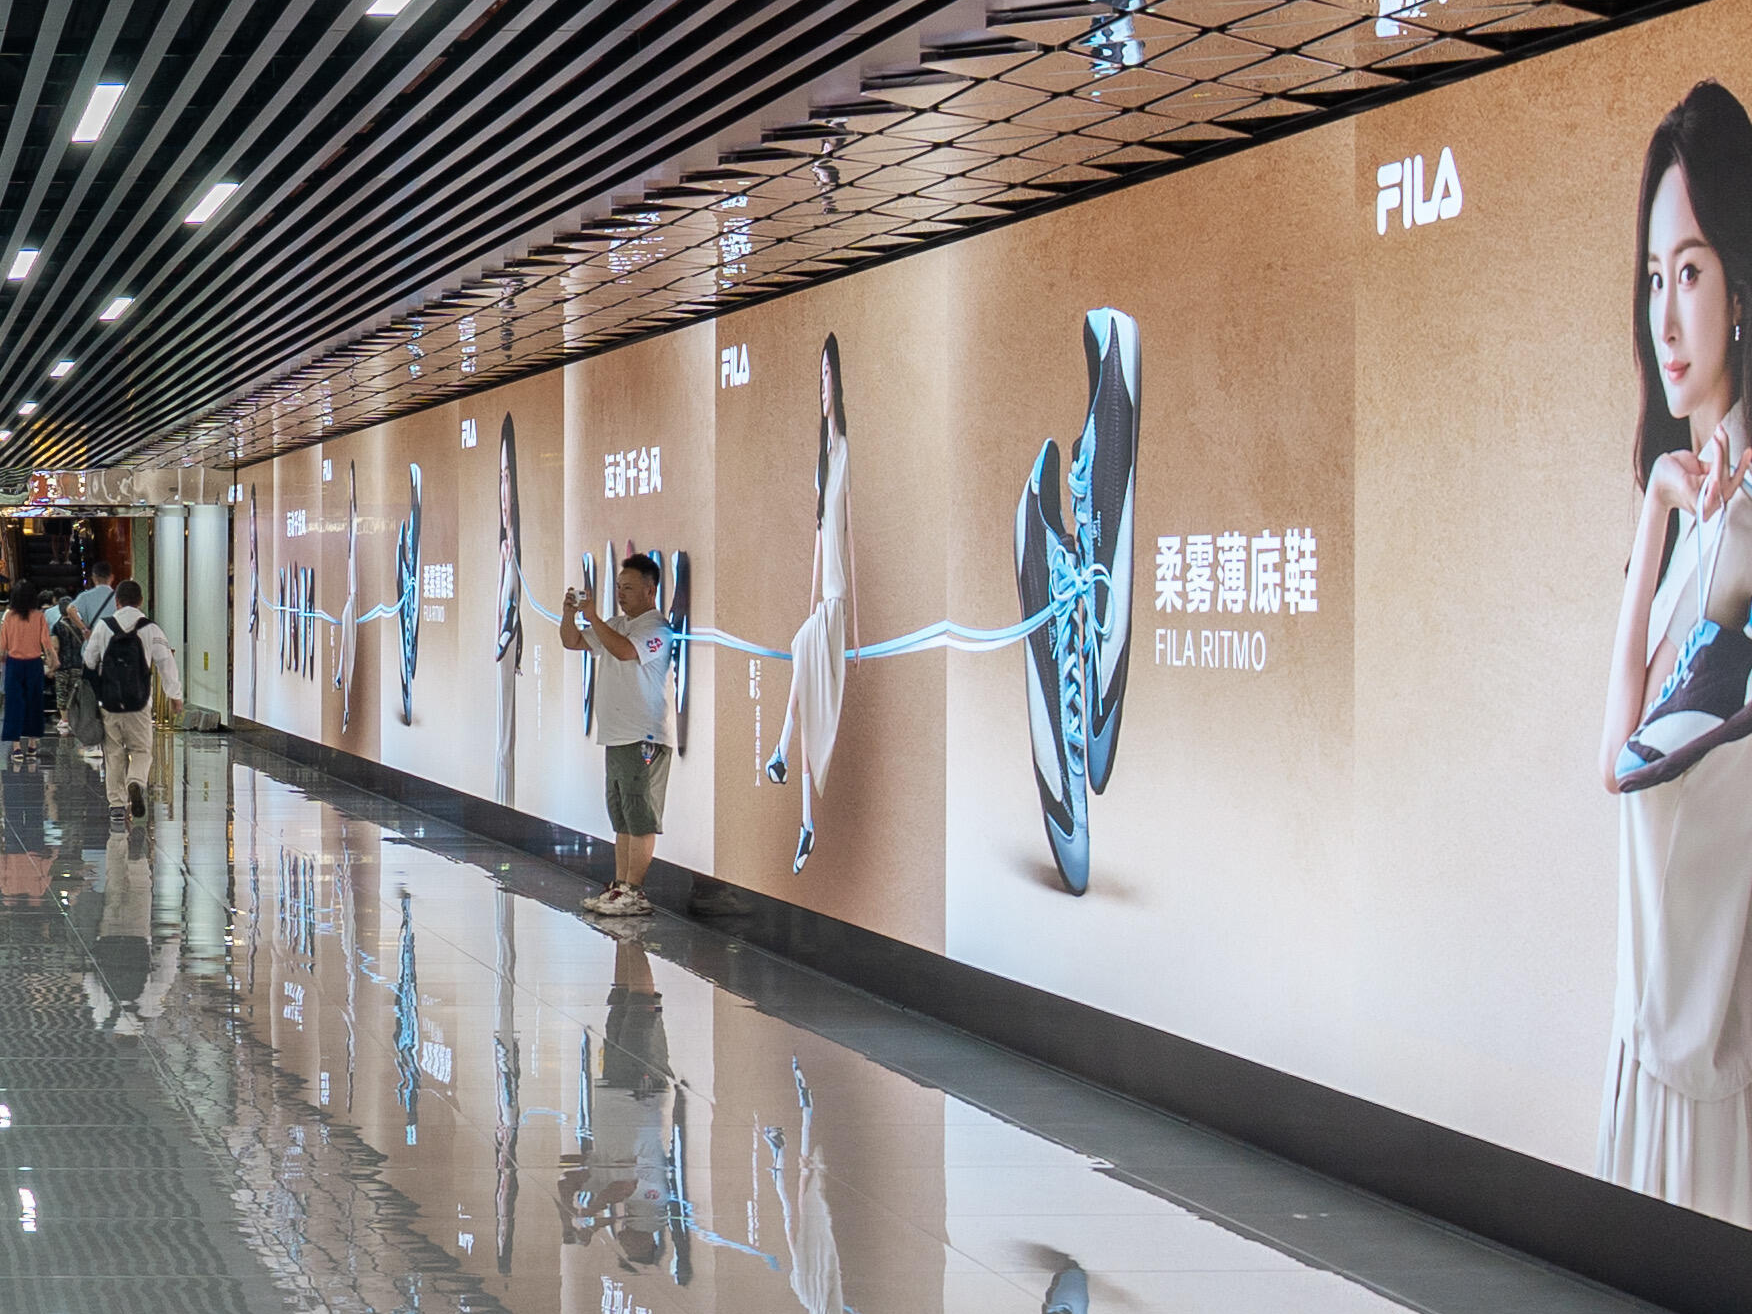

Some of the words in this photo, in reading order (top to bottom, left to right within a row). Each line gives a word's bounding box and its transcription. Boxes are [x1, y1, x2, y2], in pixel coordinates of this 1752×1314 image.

[1377, 147, 1462, 235] FILA
[722, 344, 750, 389] FILA
[462, 419, 477, 448] FILA
[604, 447, 661, 498] 运动千金风
[1155, 528, 1318, 614] 柔雾薄底鞋
[1155, 629, 1196, 666] FILA
[1200, 631, 1267, 671] RITMO
